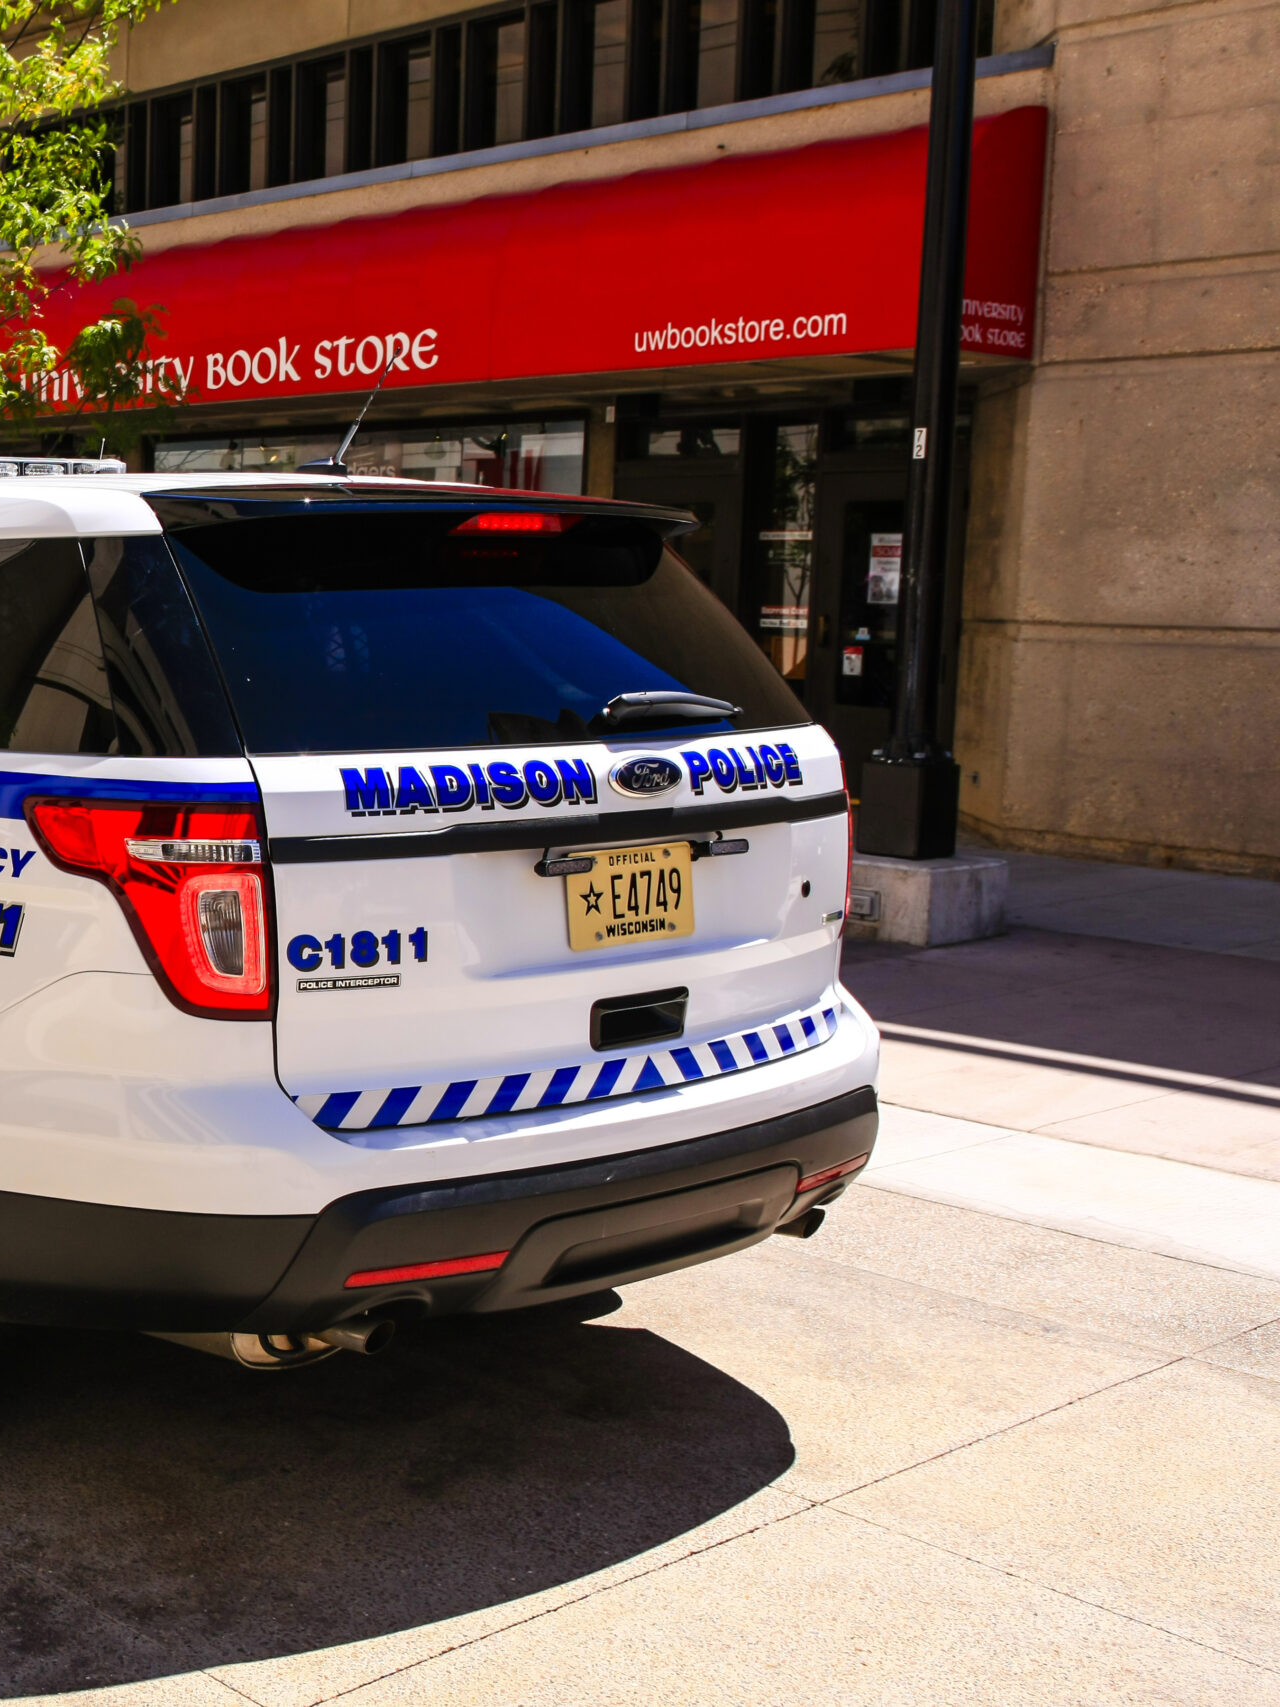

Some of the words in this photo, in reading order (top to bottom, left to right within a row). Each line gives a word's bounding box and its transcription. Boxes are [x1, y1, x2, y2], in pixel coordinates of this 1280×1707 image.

[962, 299, 1025, 326] NIVERSITY
[634, 312, 848, 352] uwbookstore.com
[339, 758, 598, 817] MADISON
[680, 744, 803, 795] POLICE
[631, 762, 671, 788] Ford
[609, 852, 656, 866] OFFICIAL
[606, 918, 666, 938] WISCONSIN
[287, 927, 428, 972] C1811
[300, 980, 333, 990] POLICE
[336, 976, 398, 988] INTERCEPTOR
